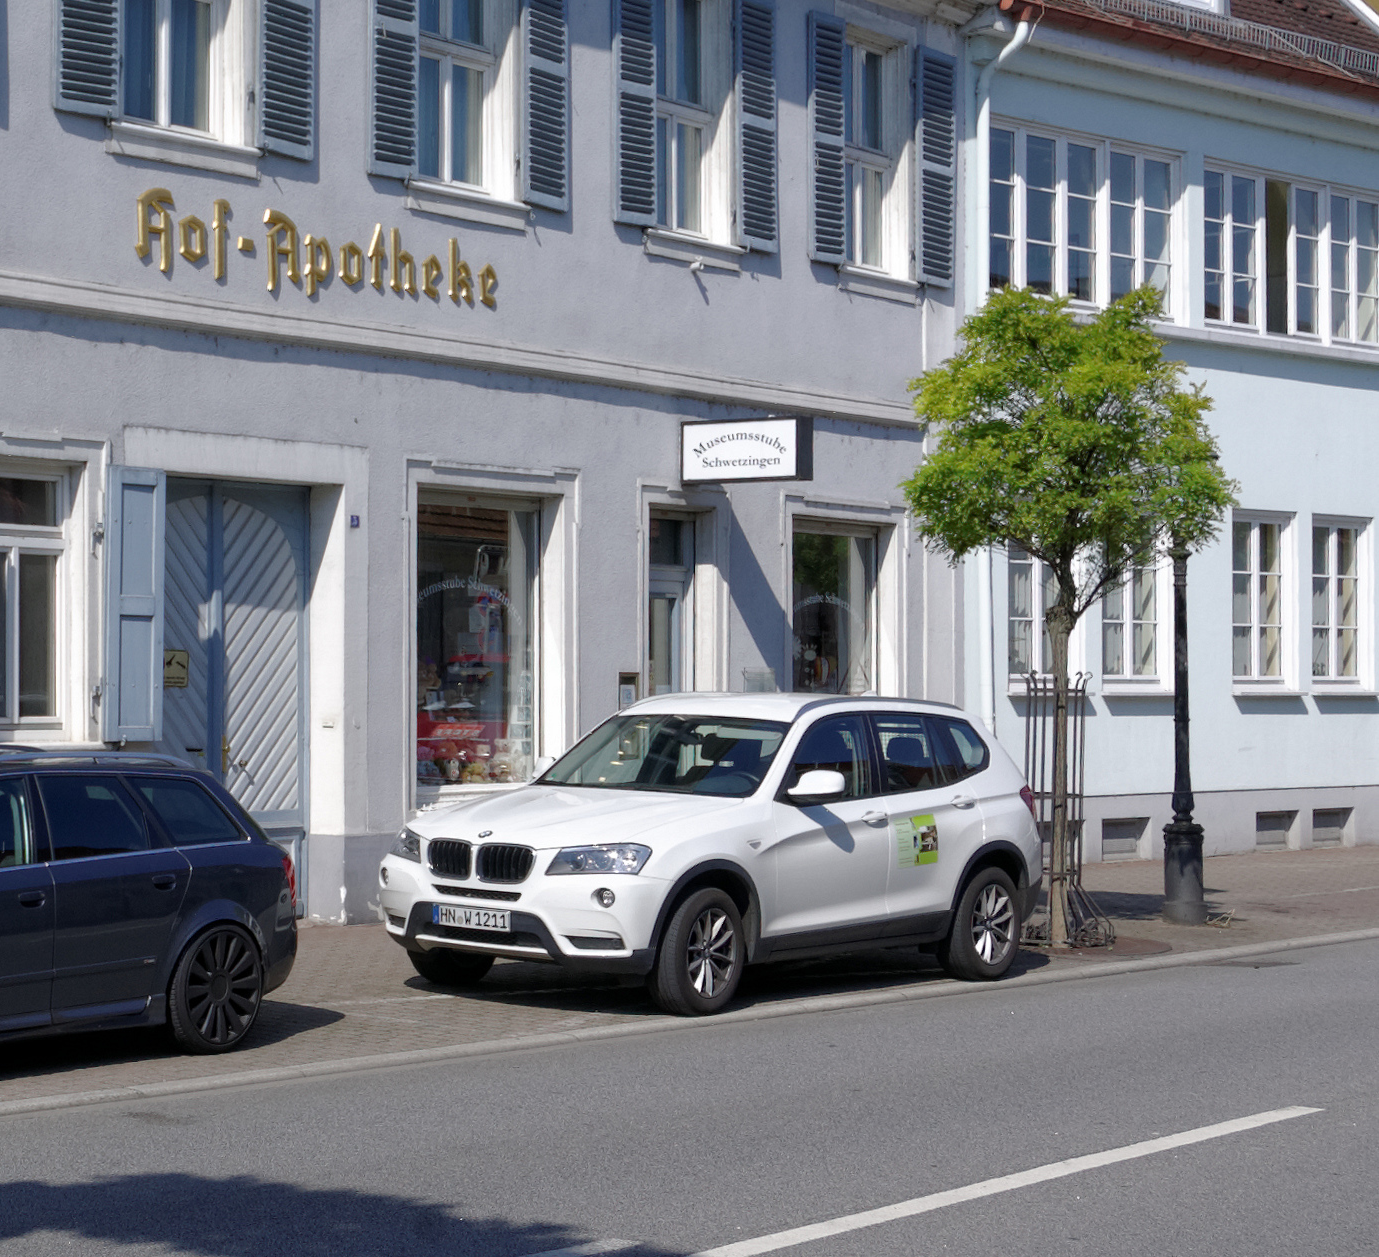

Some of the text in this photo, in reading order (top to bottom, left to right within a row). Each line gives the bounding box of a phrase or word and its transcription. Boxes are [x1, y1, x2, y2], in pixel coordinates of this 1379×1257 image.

[135, 187, 497, 308] Hof-Apotheke
[692, 431, 787, 458] Museumsstube
[702, 455, 781, 469] Schwetzingen
[441, 908, 508, 929] HN W 1211
